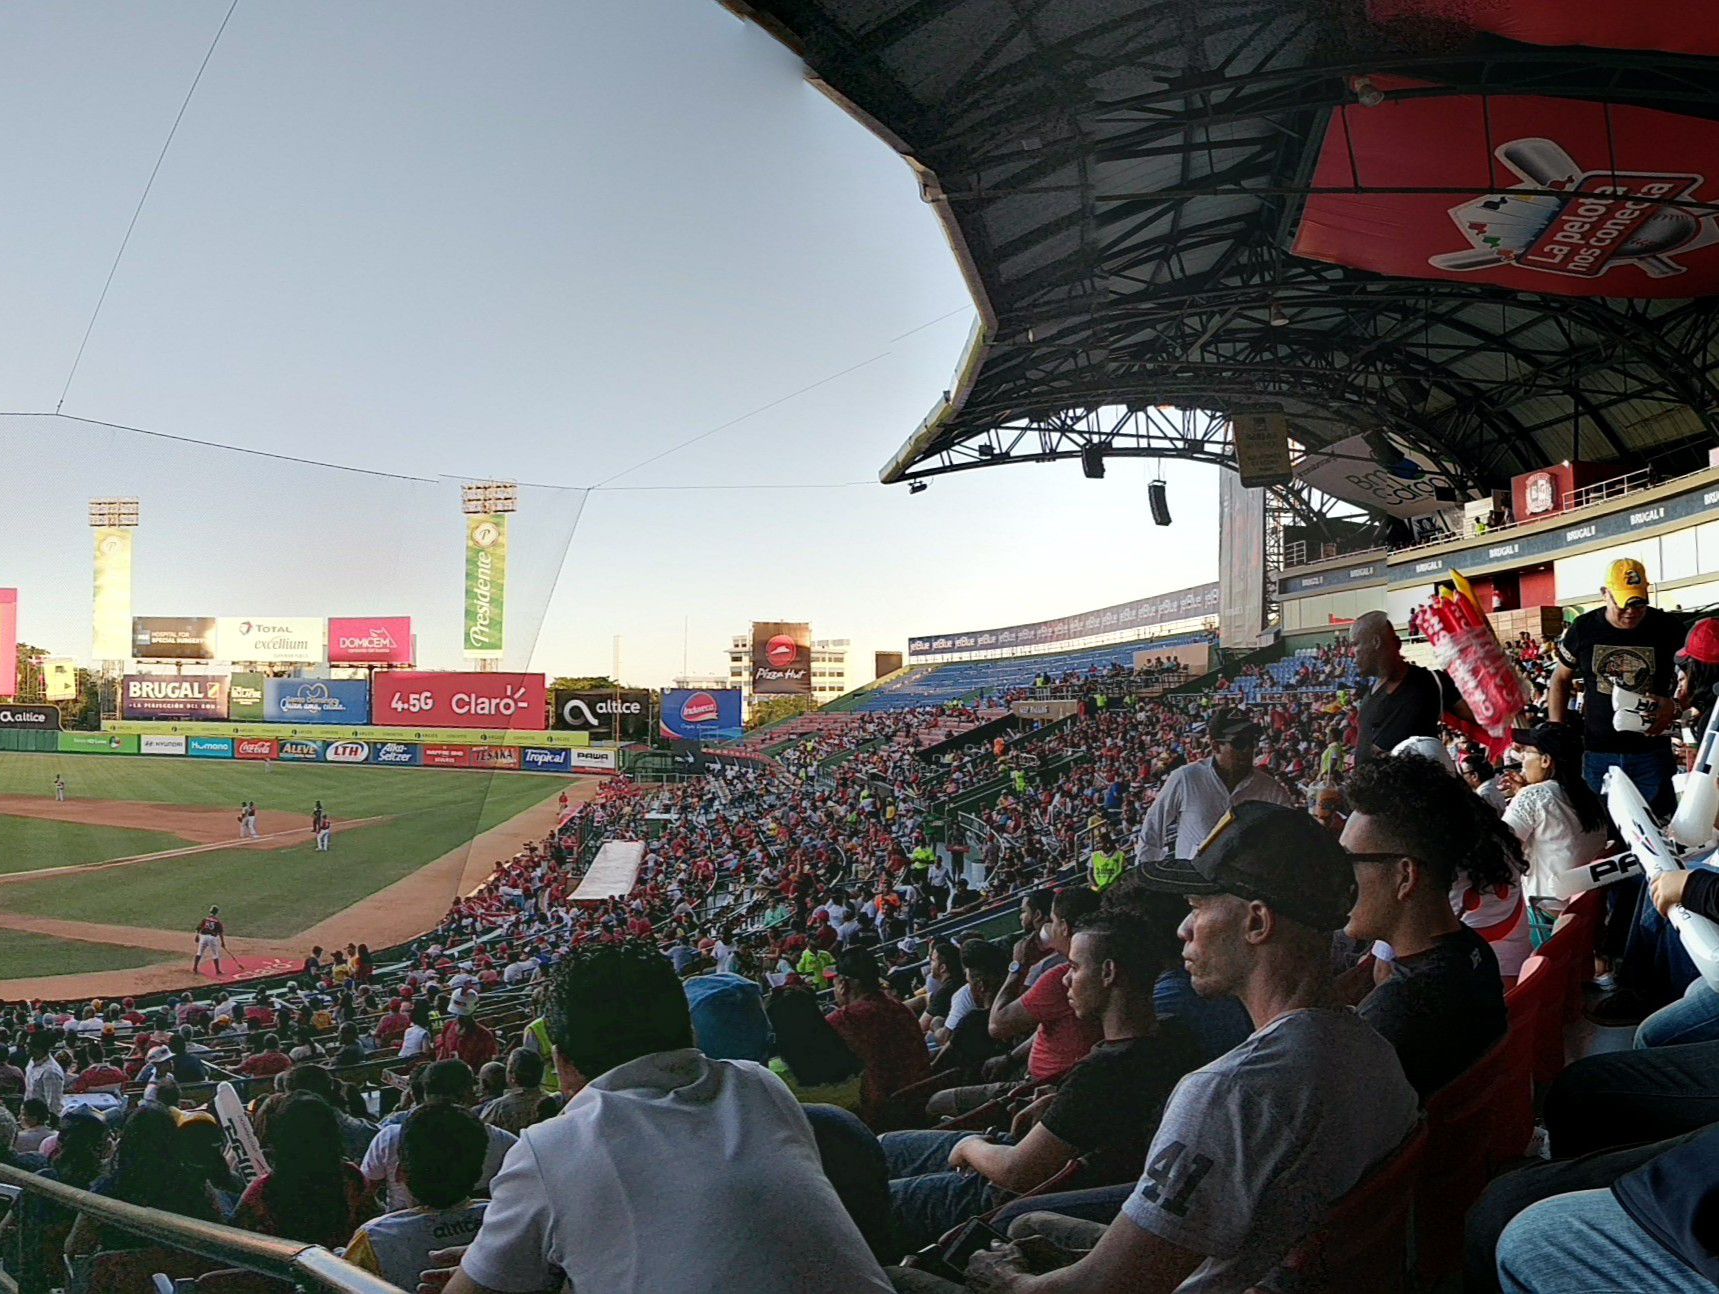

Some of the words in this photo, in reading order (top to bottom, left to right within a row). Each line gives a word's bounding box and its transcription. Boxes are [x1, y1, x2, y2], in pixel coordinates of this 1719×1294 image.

[1527, 244, 1570, 264] La
[1567, 247, 1600, 271] nos
[1630, 509, 1658, 526] BRUGAL
[1566, 527, 1590, 543] BRUGAL
[1489, 546, 1513, 560] BRUGAL
[1415, 561, 1437, 574] BRUGAL
[469, 551, 492, 647] Presidente
[255, 636, 308, 650] excellium
[340, 637, 389, 649] DOMICEM
[756, 668, 784, 680] Pizza
[784, 668, 807, 680] Hut
[129, 681, 204, 699] BRUGAL
[391, 691, 433, 713] 4.5G
[451, 693, 516, 715] Claro
[596, 700, 641, 714] altice
[16, 712, 46, 723] altice
[239, 741, 271, 754] Coca-Cola
[283, 743, 315, 754] ALEVE
[335, 745, 359, 756] LTH
[383, 743, 407, 753] Alka-
[378, 751, 412, 763] Seltzer
[525, 749, 565, 765] Tropical
[577, 753, 608, 761] PAWA
[1142, 1141, 1214, 1217] 41
